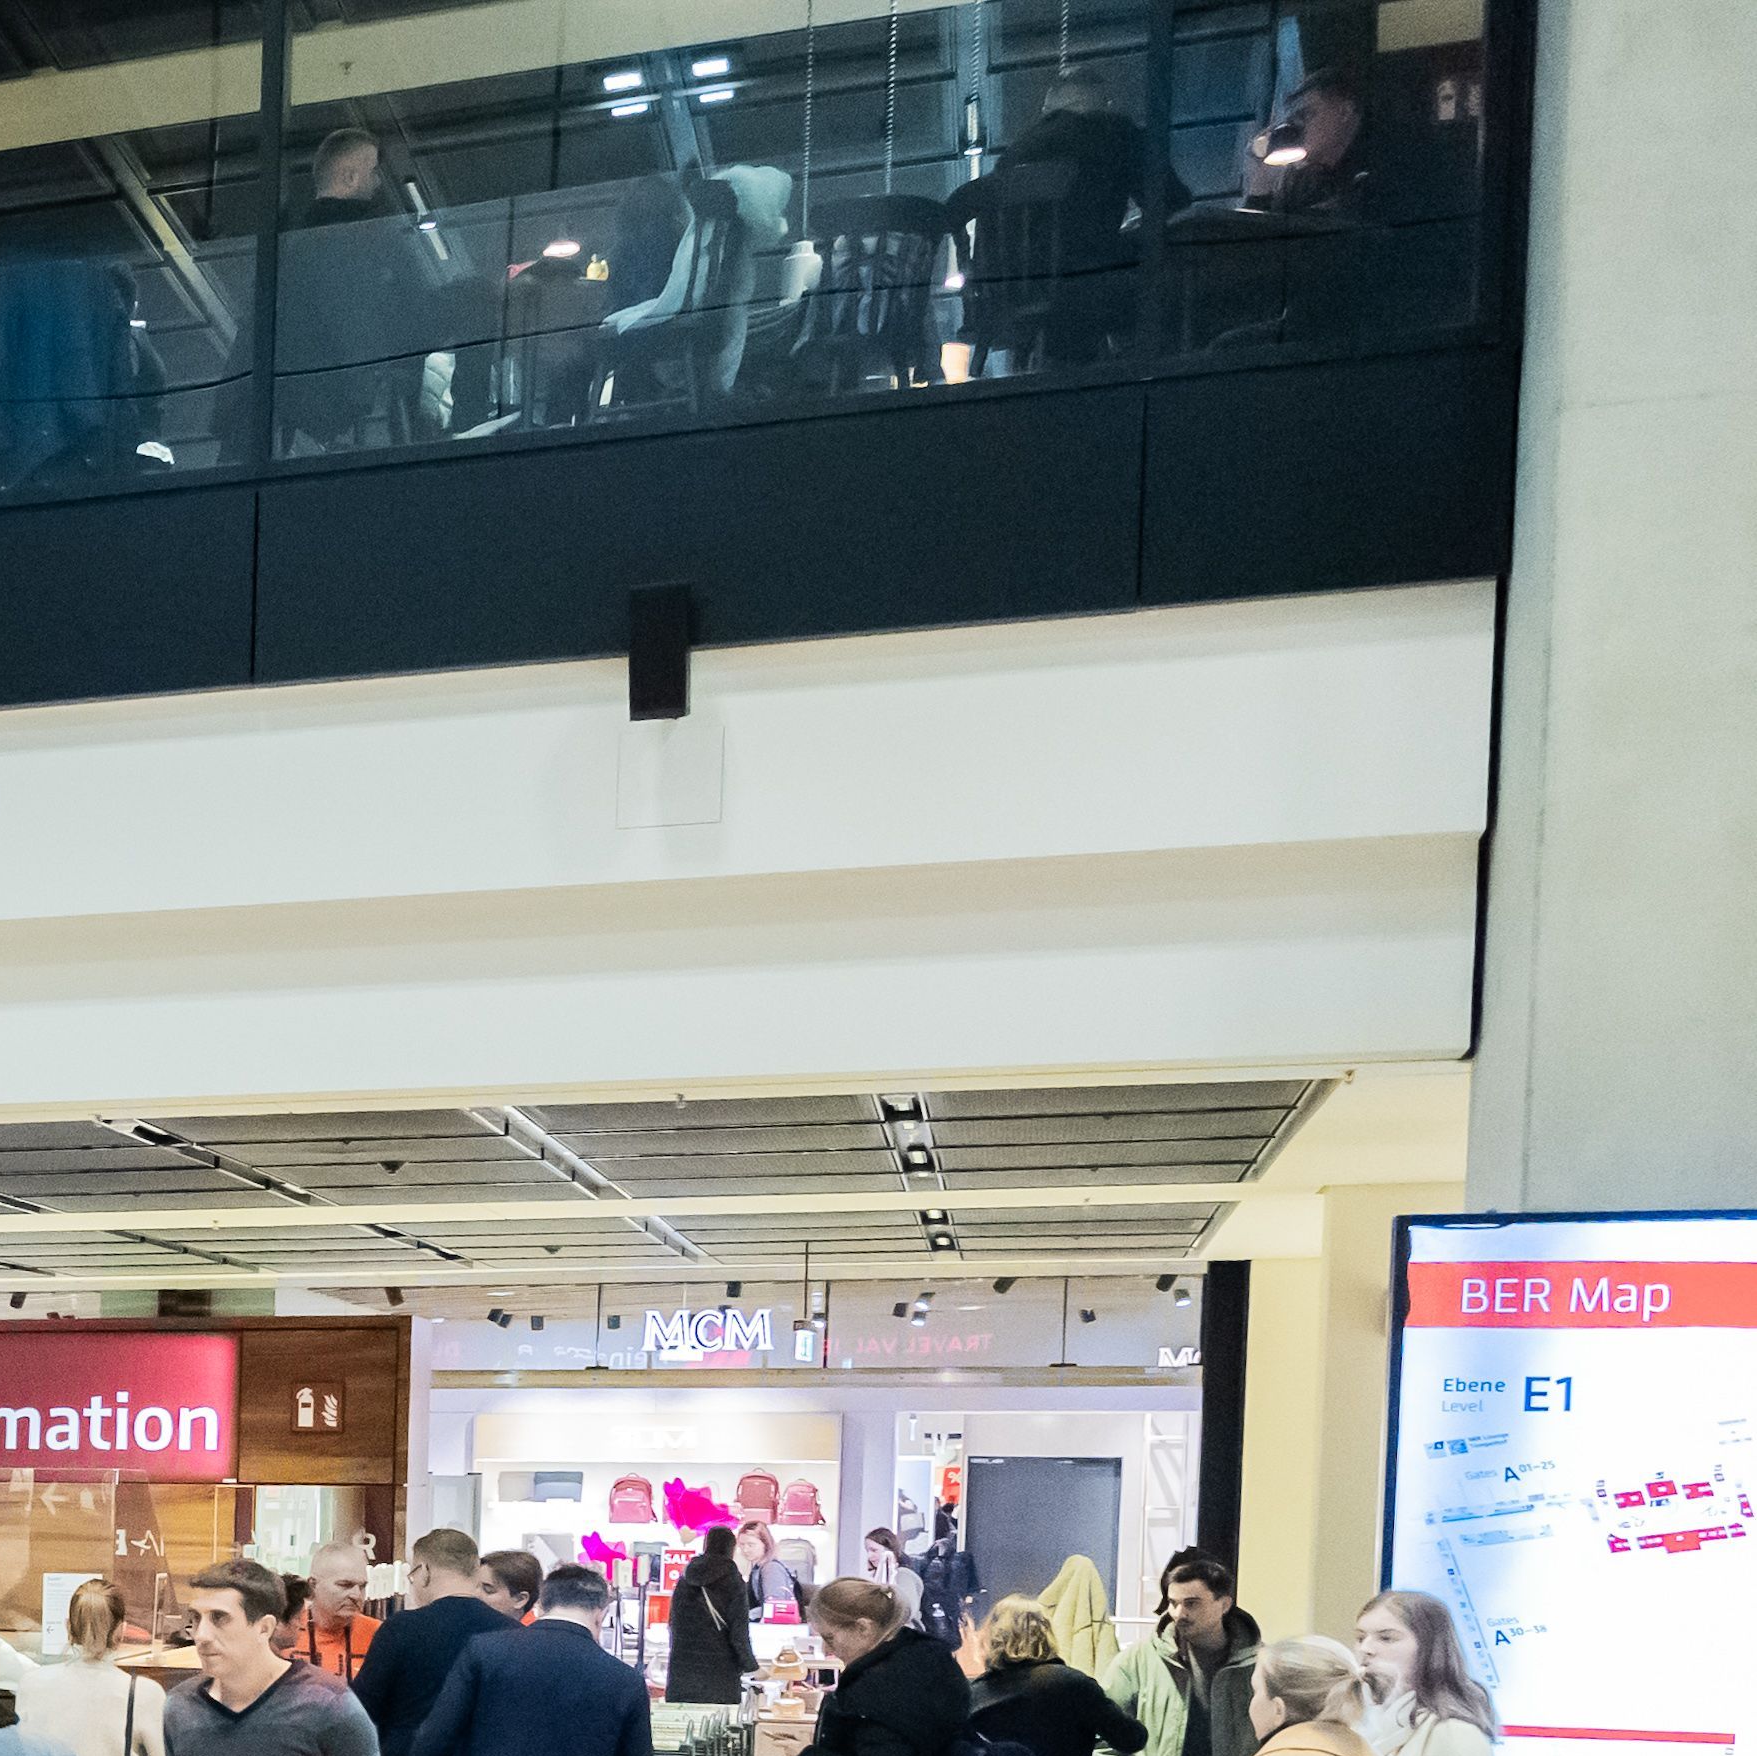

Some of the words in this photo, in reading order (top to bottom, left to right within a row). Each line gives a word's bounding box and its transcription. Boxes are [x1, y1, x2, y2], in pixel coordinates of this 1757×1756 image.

[1461, 1278, 1551, 1314] BER
[1569, 1277, 1671, 1322] Map
[642, 1309, 774, 1353] MCM
[1443, 1378, 1506, 1393] Ebene
[1523, 1376, 1573, 1412] E1
[1441, 1400, 1484, 1413] Level
